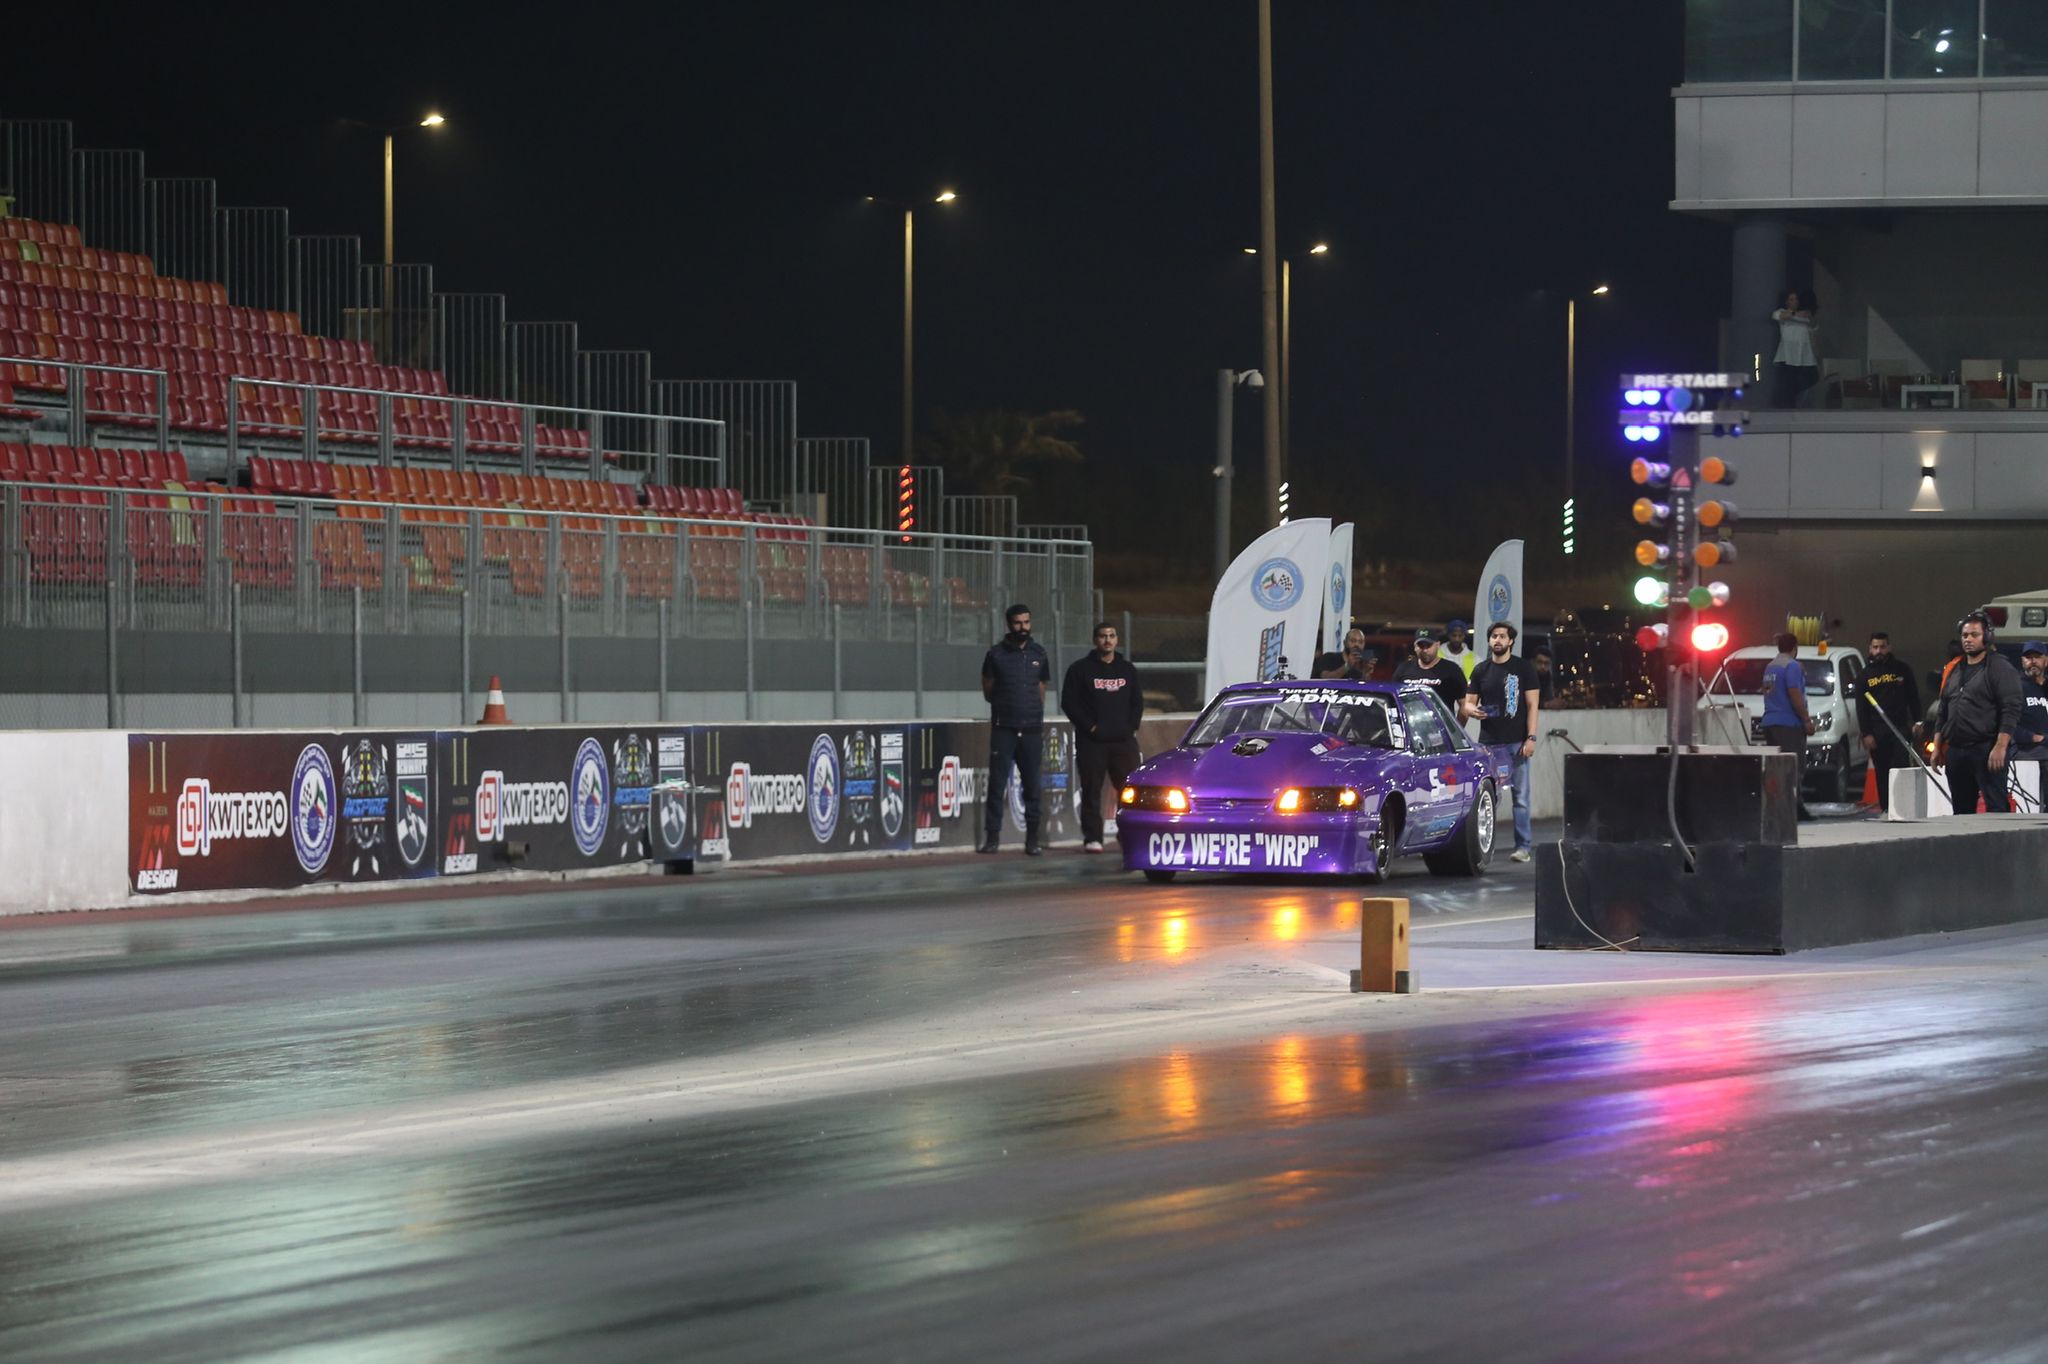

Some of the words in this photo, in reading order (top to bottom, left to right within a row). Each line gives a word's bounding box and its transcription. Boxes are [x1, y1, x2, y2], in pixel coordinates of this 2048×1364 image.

[1634, 374, 1728, 388] PRE-STAGE
[1648, 411, 1714, 424] STAGE
[1284, 694, 1374, 707] ADNAN
[1149, 833, 1186, 865] COZ
[1191, 833, 1250, 866] WE'RE
[1255, 833, 1319, 867] "WRP"
[137, 869, 178, 890] DESIGN
